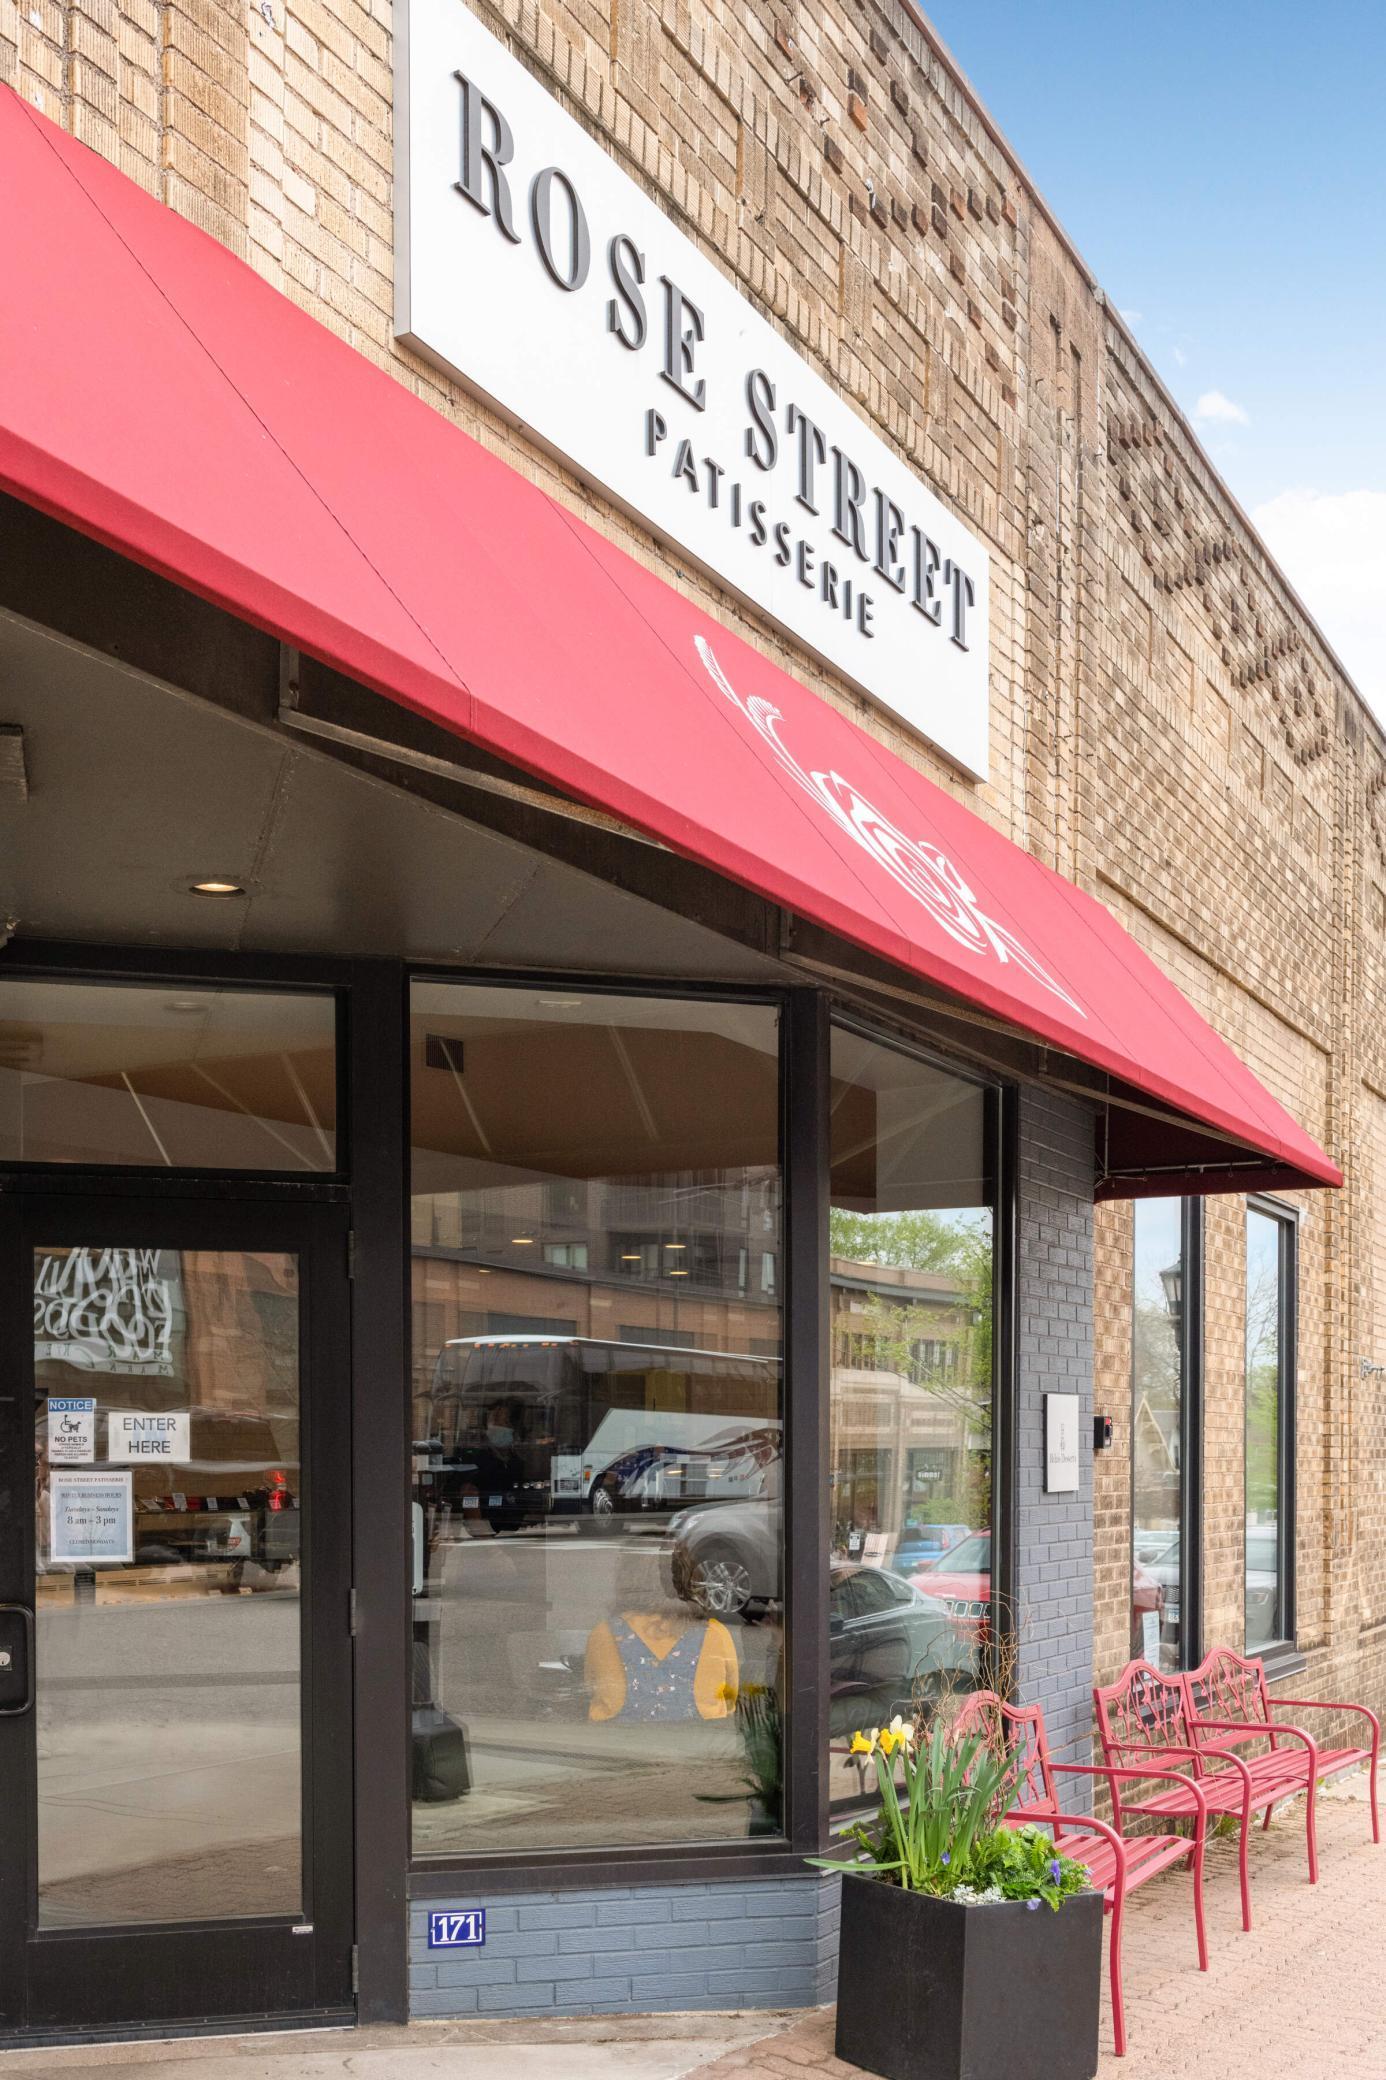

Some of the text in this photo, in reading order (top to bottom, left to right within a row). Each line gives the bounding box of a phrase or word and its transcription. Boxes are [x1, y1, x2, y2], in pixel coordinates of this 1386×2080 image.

[453, 69, 975, 652] ROSE STREET
[645, 408, 875, 638] PATISSERIE
[50, 1401, 92, 1410] NOTICE
[123, 1417, 176, 1431] ENTER
[128, 1440, 171, 1454] HERE
[67, 1516, 73, 1524] 8
[96, 1516, 102, 1524] 3
[103, 1518, 116, 1526] pm
[438, 1914, 477, 1941] 171
